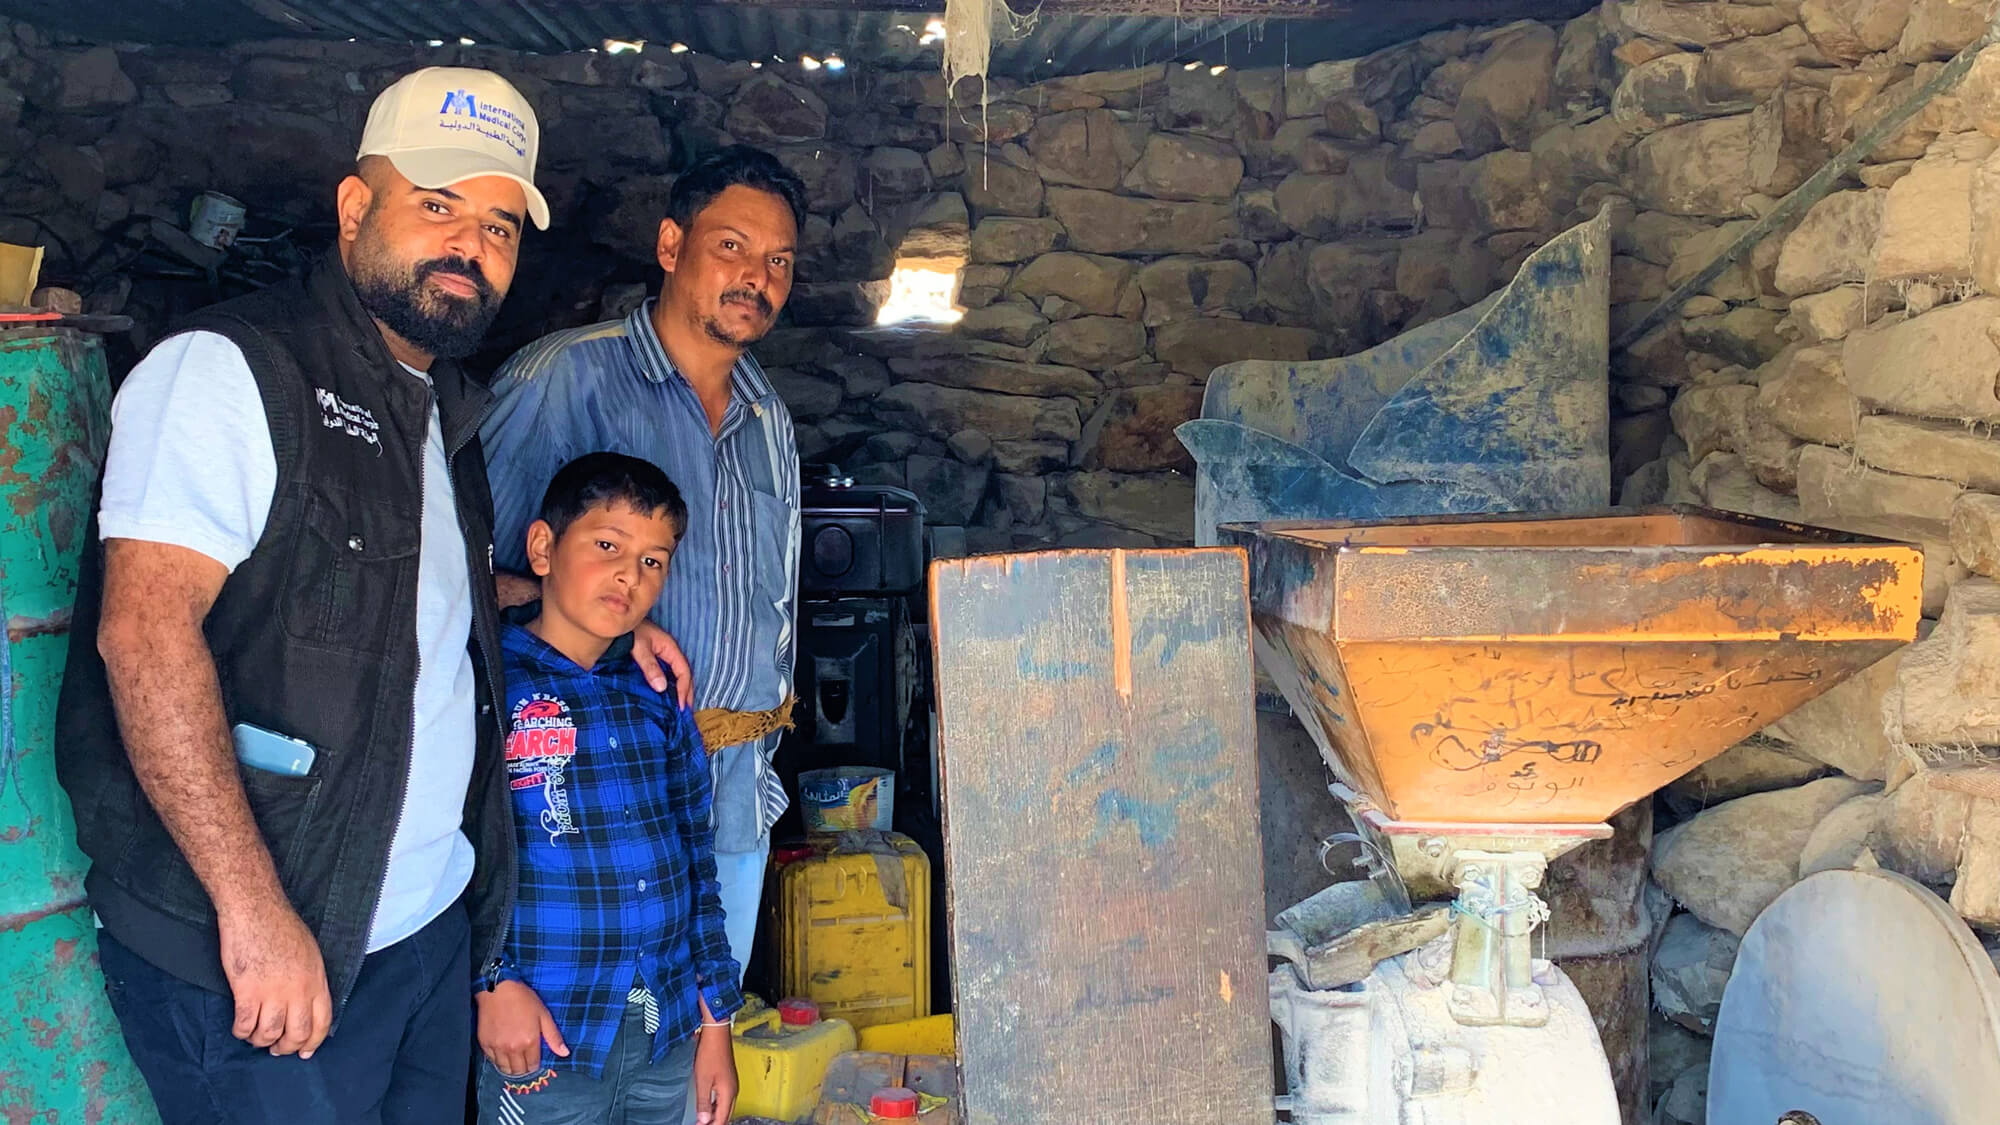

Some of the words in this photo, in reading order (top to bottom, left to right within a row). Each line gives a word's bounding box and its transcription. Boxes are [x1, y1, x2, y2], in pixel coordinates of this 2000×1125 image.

[439, 119, 475, 132] الدولية
[480, 112, 511, 129] Medical
[476, 124, 506, 141] الطبية
[505, 728, 577, 760] EARCH
